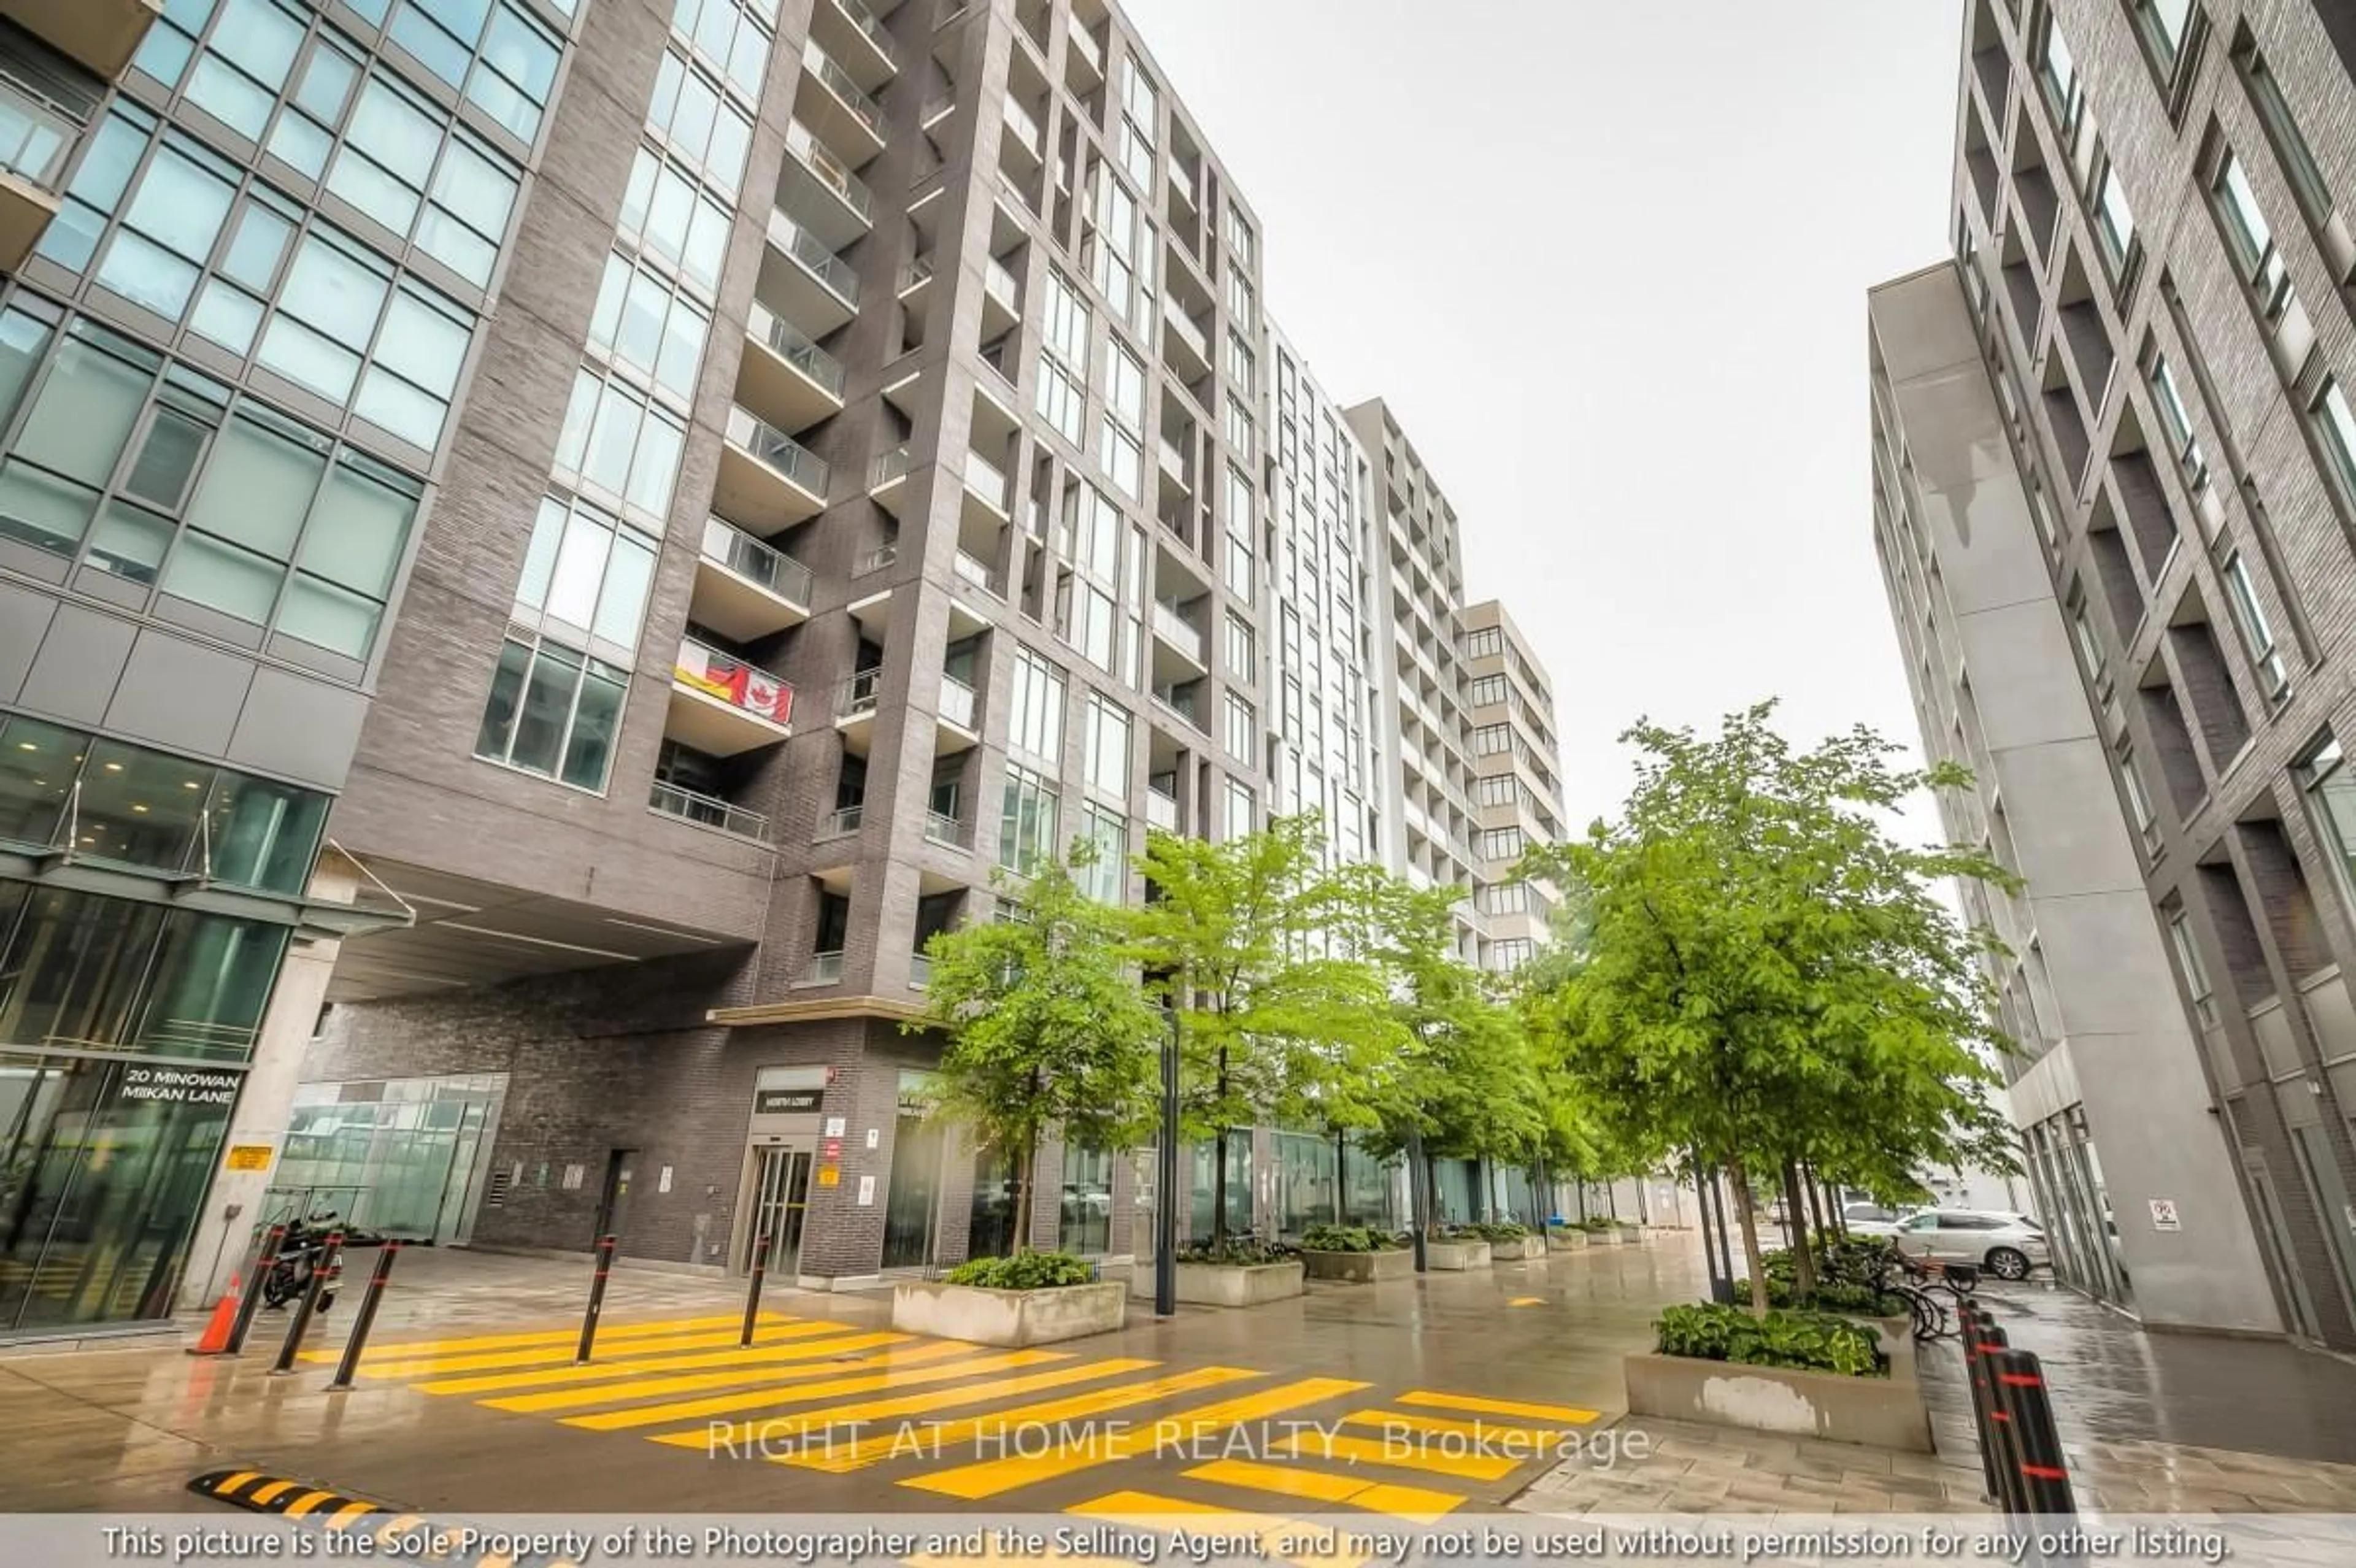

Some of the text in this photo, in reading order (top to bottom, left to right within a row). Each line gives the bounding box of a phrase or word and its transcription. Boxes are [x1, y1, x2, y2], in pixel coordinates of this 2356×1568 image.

[127, 1070, 239, 1088] 20 MINOWAN
[188, 1090, 236, 1103] LANE
